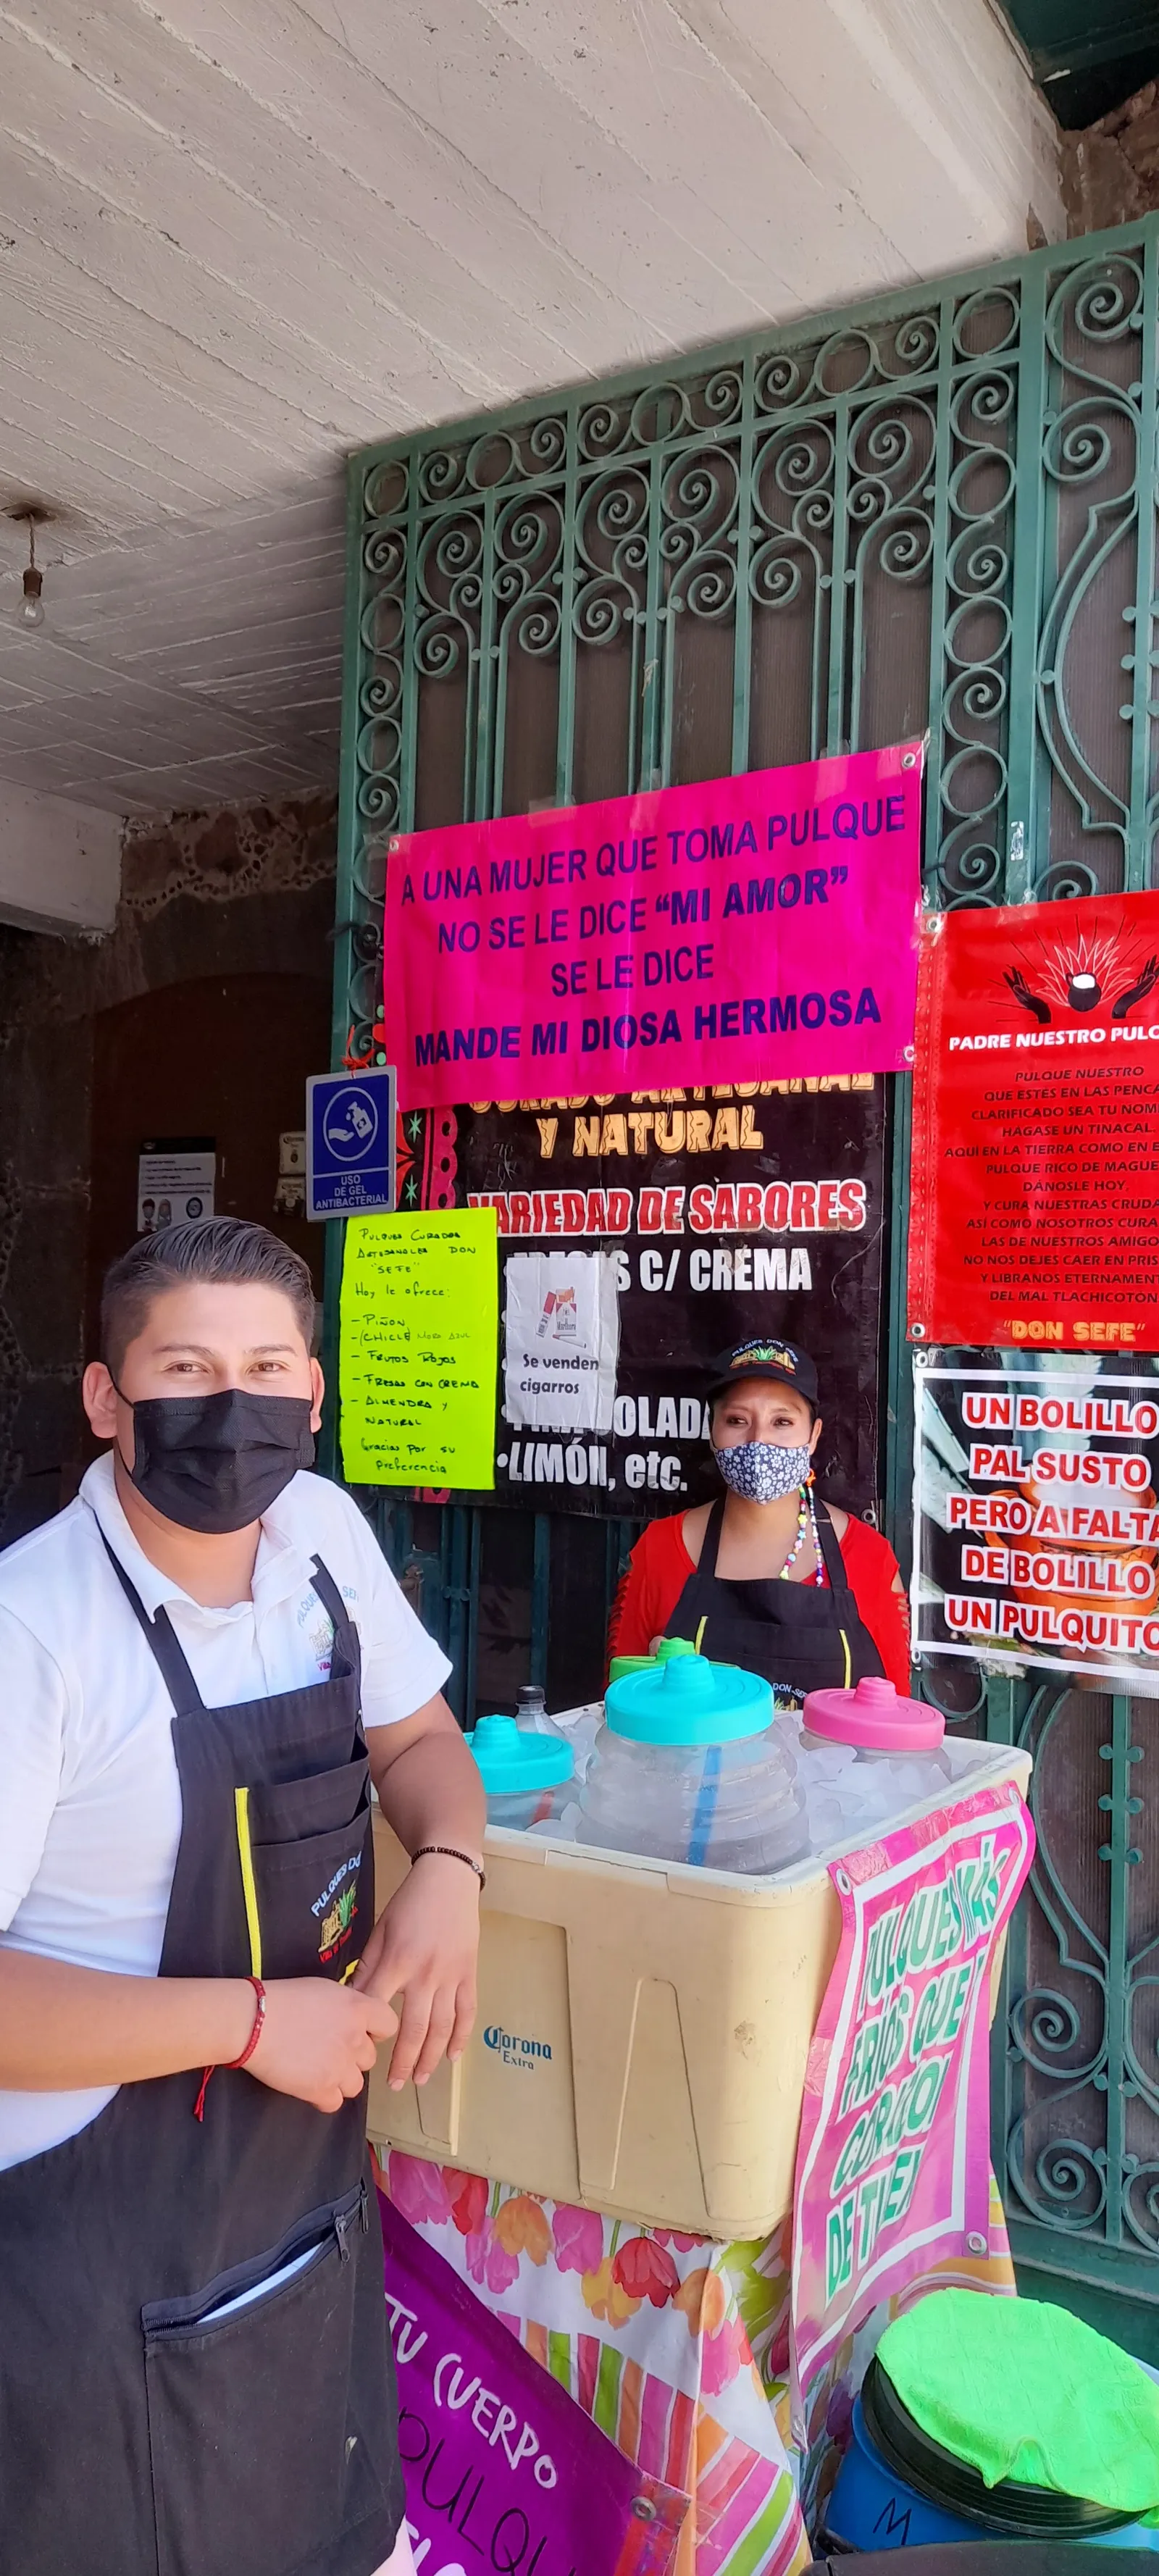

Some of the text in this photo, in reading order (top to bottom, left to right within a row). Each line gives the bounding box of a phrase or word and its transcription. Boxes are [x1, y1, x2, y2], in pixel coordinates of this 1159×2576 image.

[401, 795, 906, 906] A UNA MUJER QUE TOMA PULQUE
[438, 921, 480, 954] NO
[488, 914, 525, 950] SE
[535, 909, 568, 944] LE
[580, 898, 646, 937] DICE
[551, 945, 715, 998] SE LE DICE
[415, 988, 882, 1068] MANDE MI DIOSA HERMOSA
[949, 1034, 1011, 1051] PADRE
[1016, 1029, 1106, 1048] NUESTRO
[1015, 1066, 1145, 1082] PULQUE NUESTRO
[984, 1090, 1013, 1102] QUE
[1060, 1087, 1080, 1098] EN
[1084, 1085, 1110, 1097] LAS
[971, 1103, 1159, 1121] CLARIFICADO SEA TU NOM
[536, 1104, 763, 1159] Y NATURAL
[1063, 1124, 1084, 1136] UN
[982, 1146, 1000, 1156] EN
[1003, 1145, 1021, 1155] LA
[1025, 1143, 1074, 1155] TIERRA
[1079, 1142, 1123, 1153] COMO
[1128, 1141, 1147, 1153] EN
[986, 1161, 1159, 1174] PULQUE RICO DE MAGUE
[334, 1184, 367, 1197] DE GEL
[340, 1174, 361, 1186] USO
[1022, 1179, 1089, 1192] DÁNOSLE
[315, 1193, 388, 1210] ANTIBACTERIAL
[638, 1186, 685, 1234] DE
[689, 1179, 867, 1233] SABORES
[983, 1201, 992, 1211] Y
[994, 1200, 1030, 1210] CURA
[1034, 1199, 1108, 1210] NUESTRAS
[990, 1218, 1032, 1229] COMO
[1036, 1218, 1113, 1229] NOSOTROS
[982, 1236, 1159, 1247] LAS DE NUESTROS AMIGO
[639, 1248, 679, 1292] C/
[690, 1247, 813, 1292] CREMA
[963, 1255, 984, 1266] NO
[987, 1255, 1016, 1266] NOS
[1018, 1255, 1059, 1266] DEJES
[1063, 1255, 1101, 1266] CAER
[1104, 1255, 1124, 1266] EN
[980, 1274, 989, 1284] Y
[355, 1281, 375, 1299] Hoy
[386, 1284, 396, 1295] le
[989, 1291, 1014, 1302] DEL
[1018, 1291, 1049, 1302] MAL
[523, 1353, 599, 1371] Se venden
[520, 1378, 580, 1394] cigarros
[593, 1395, 711, 1439] OLAD
[966, 1396, 1158, 1435] UN BOLILLO
[509, 1437, 687, 1492] LIMÓN, etc.
[974, 1448, 1147, 1486] PAL SUSTO
[951, 1497, 1027, 1531] PERO
[1037, 1507, 1061, 1534] A
[966, 1550, 1150, 1595] DE BOLILLO
[949, 1599, 1159, 1649] UN PULQUITO
[773, 1682, 792, 1693] DON
[311, 1863, 347, 1917] PULQUES
[348, 1850, 362, 1870] DO
[913, 1963, 972, 2057] QUE
[483, 2025, 553, 2060] Corona
[503, 2050, 535, 2070] Extra
[828, 2194, 855, 2302] DE
[385, 2293, 428, 2364] TU
[434, 2353, 558, 2489] CUERPO
[873, 2497, 912, 2546] M
